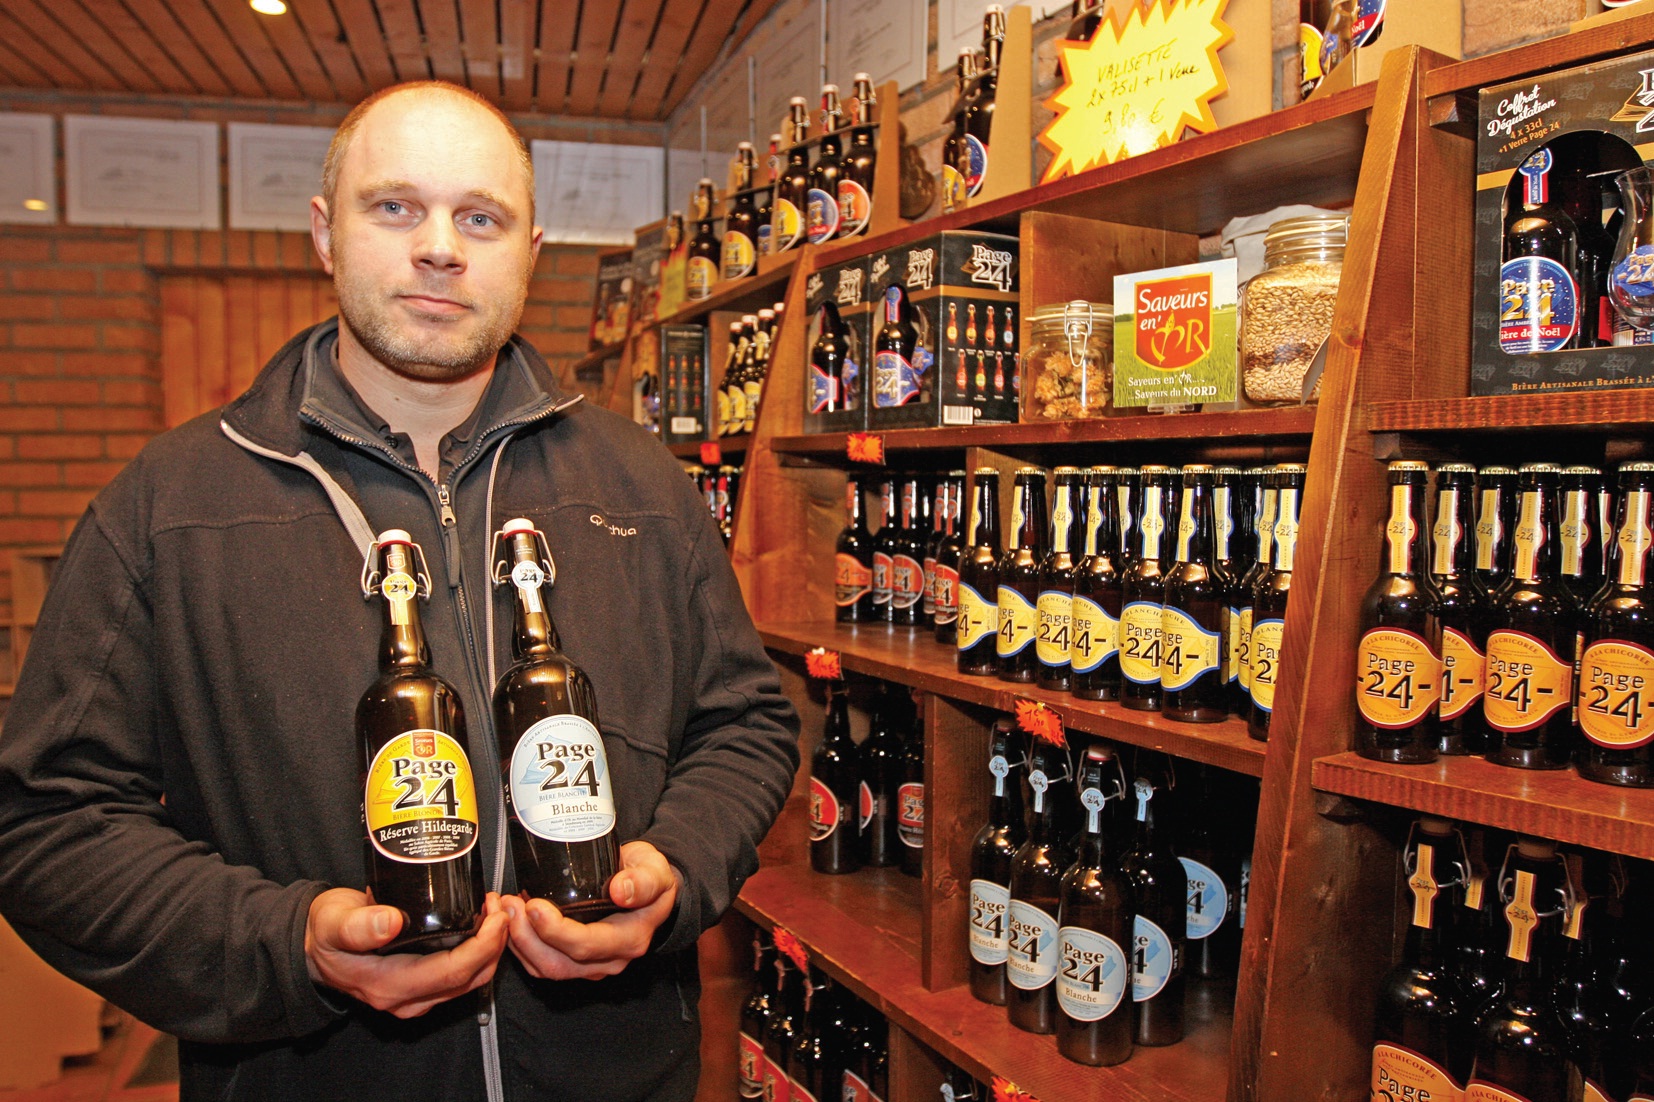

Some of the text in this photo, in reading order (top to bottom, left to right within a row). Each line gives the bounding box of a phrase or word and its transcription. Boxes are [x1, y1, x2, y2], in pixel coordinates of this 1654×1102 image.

[1099, 39, 1177, 82] VALISETTE
[1497, 84, 1541, 117] Coffret
[1487, 99, 1557, 137] Dégustation
[1510, 118, 1542, 139] 4 x 33cl
[1508, 136, 1529, 150] Verre
[1529, 126, 1548, 141] Page
[1549, 121, 1561, 132] 24
[908, 248, 934, 264] Page
[971, 244, 1013, 264] Page
[906, 261, 934, 290] 24
[971, 260, 1013, 292] 24
[1138, 288, 1208, 314] Saveurs
[1502, 294, 1556, 326] 24
[1140, 315, 1161, 331] en'
[1501, 330, 1519, 340] ière
[1538, 327, 1561, 337] Noël
[1128, 377, 1161, 387] Saveurs
[1170, 387, 1181, 397] du
[1183, 385, 1217, 397] NORD
[1512, 382, 1538, 391] BIÈRE
[1540, 379, 1594, 390] ARTISANALE
[1597, 376, 1635, 387] BRASSÉE
[590, 513, 637, 537] Qhua
[520, 573, 539, 583] 24
[390, 584, 409, 595] 24
[1040, 609, 1071, 627] Page
[1074, 616, 1092, 632] age
[1125, 622, 1162, 641] Page
[1163, 631, 1184, 647] age
[1379, 635, 1420, 651] CHICORÉE
[1499, 637, 1539, 654] CHICORÉE
[1367, 652, 1415, 676] Page
[1489, 654, 1533, 679] Page
[1603, 647, 1652, 666] CHICORÉE
[1590, 665, 1646, 693] Page
[536, 741, 596, 762] Page
[392, 757, 457, 780] Page
[539, 759, 601, 797] 24
[392, 776, 460, 817] 24
[392, 812, 412, 821] BIÈRE
[552, 801, 599, 816] Blanche
[379, 820, 474, 843] Réserve Hildegarde
[1187, 879, 1206, 891] ge
[972, 893, 1006, 915] Page
[1187, 890, 1205, 915] 4
[971, 906, 1005, 939] 24
[1009, 914, 1042, 937] Page
[1008, 927, 1041, 963] 24
[1064, 941, 1105, 965] Page
[1062, 956, 1104, 992] 24
[1065, 987, 1098, 1003] Blanche
[1389, 1052, 1438, 1080] CHICORÉE
